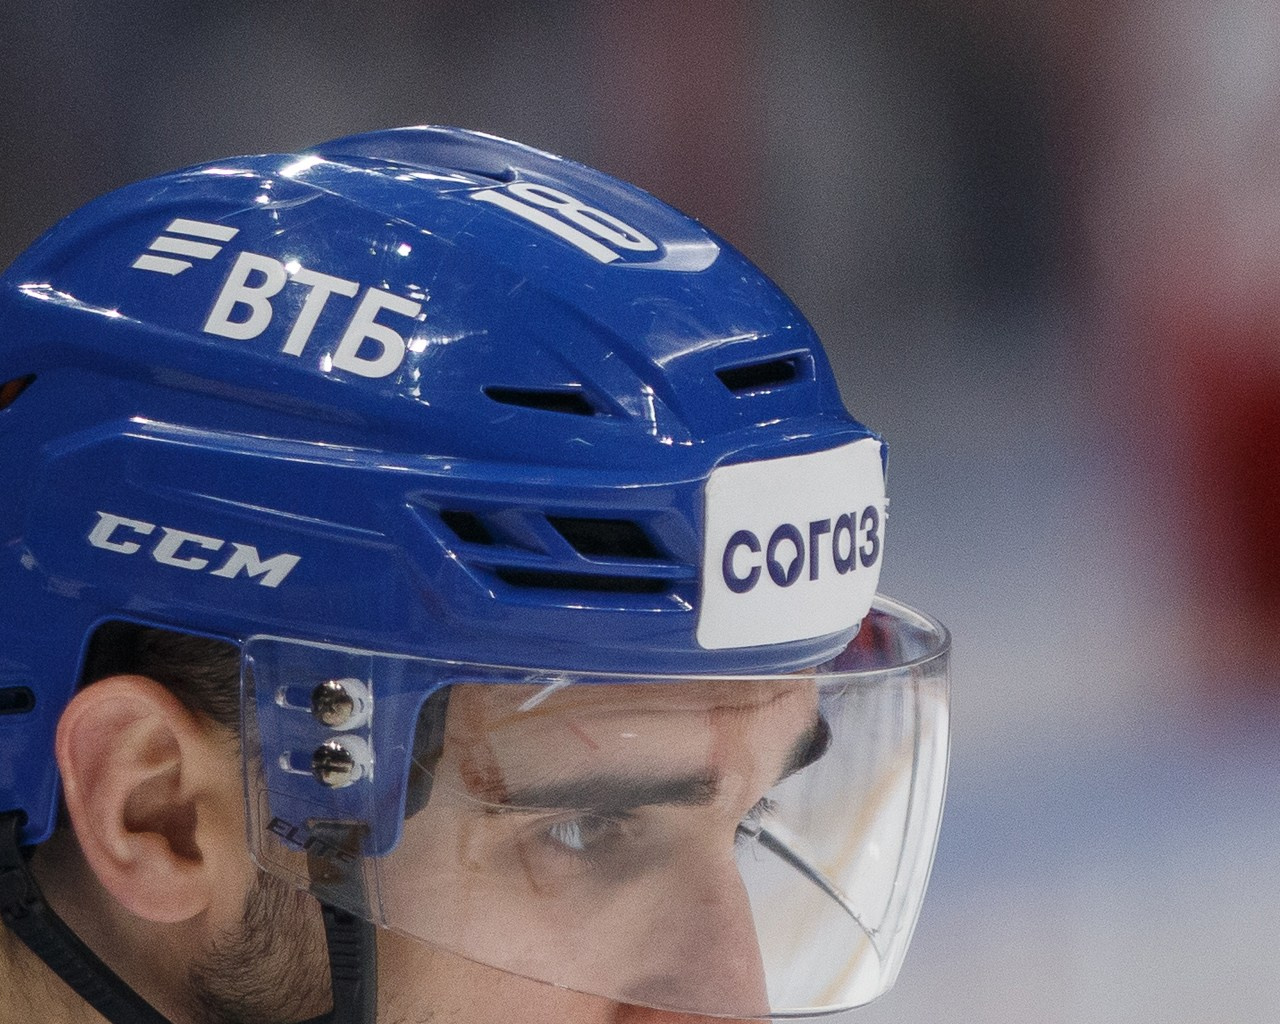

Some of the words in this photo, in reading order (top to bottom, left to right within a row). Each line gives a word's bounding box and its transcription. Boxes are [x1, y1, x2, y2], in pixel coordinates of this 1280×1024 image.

[470, 181, 658, 264] 18
[203, 250, 422, 379] ВТБ
[88, 511, 302, 588] CCM
